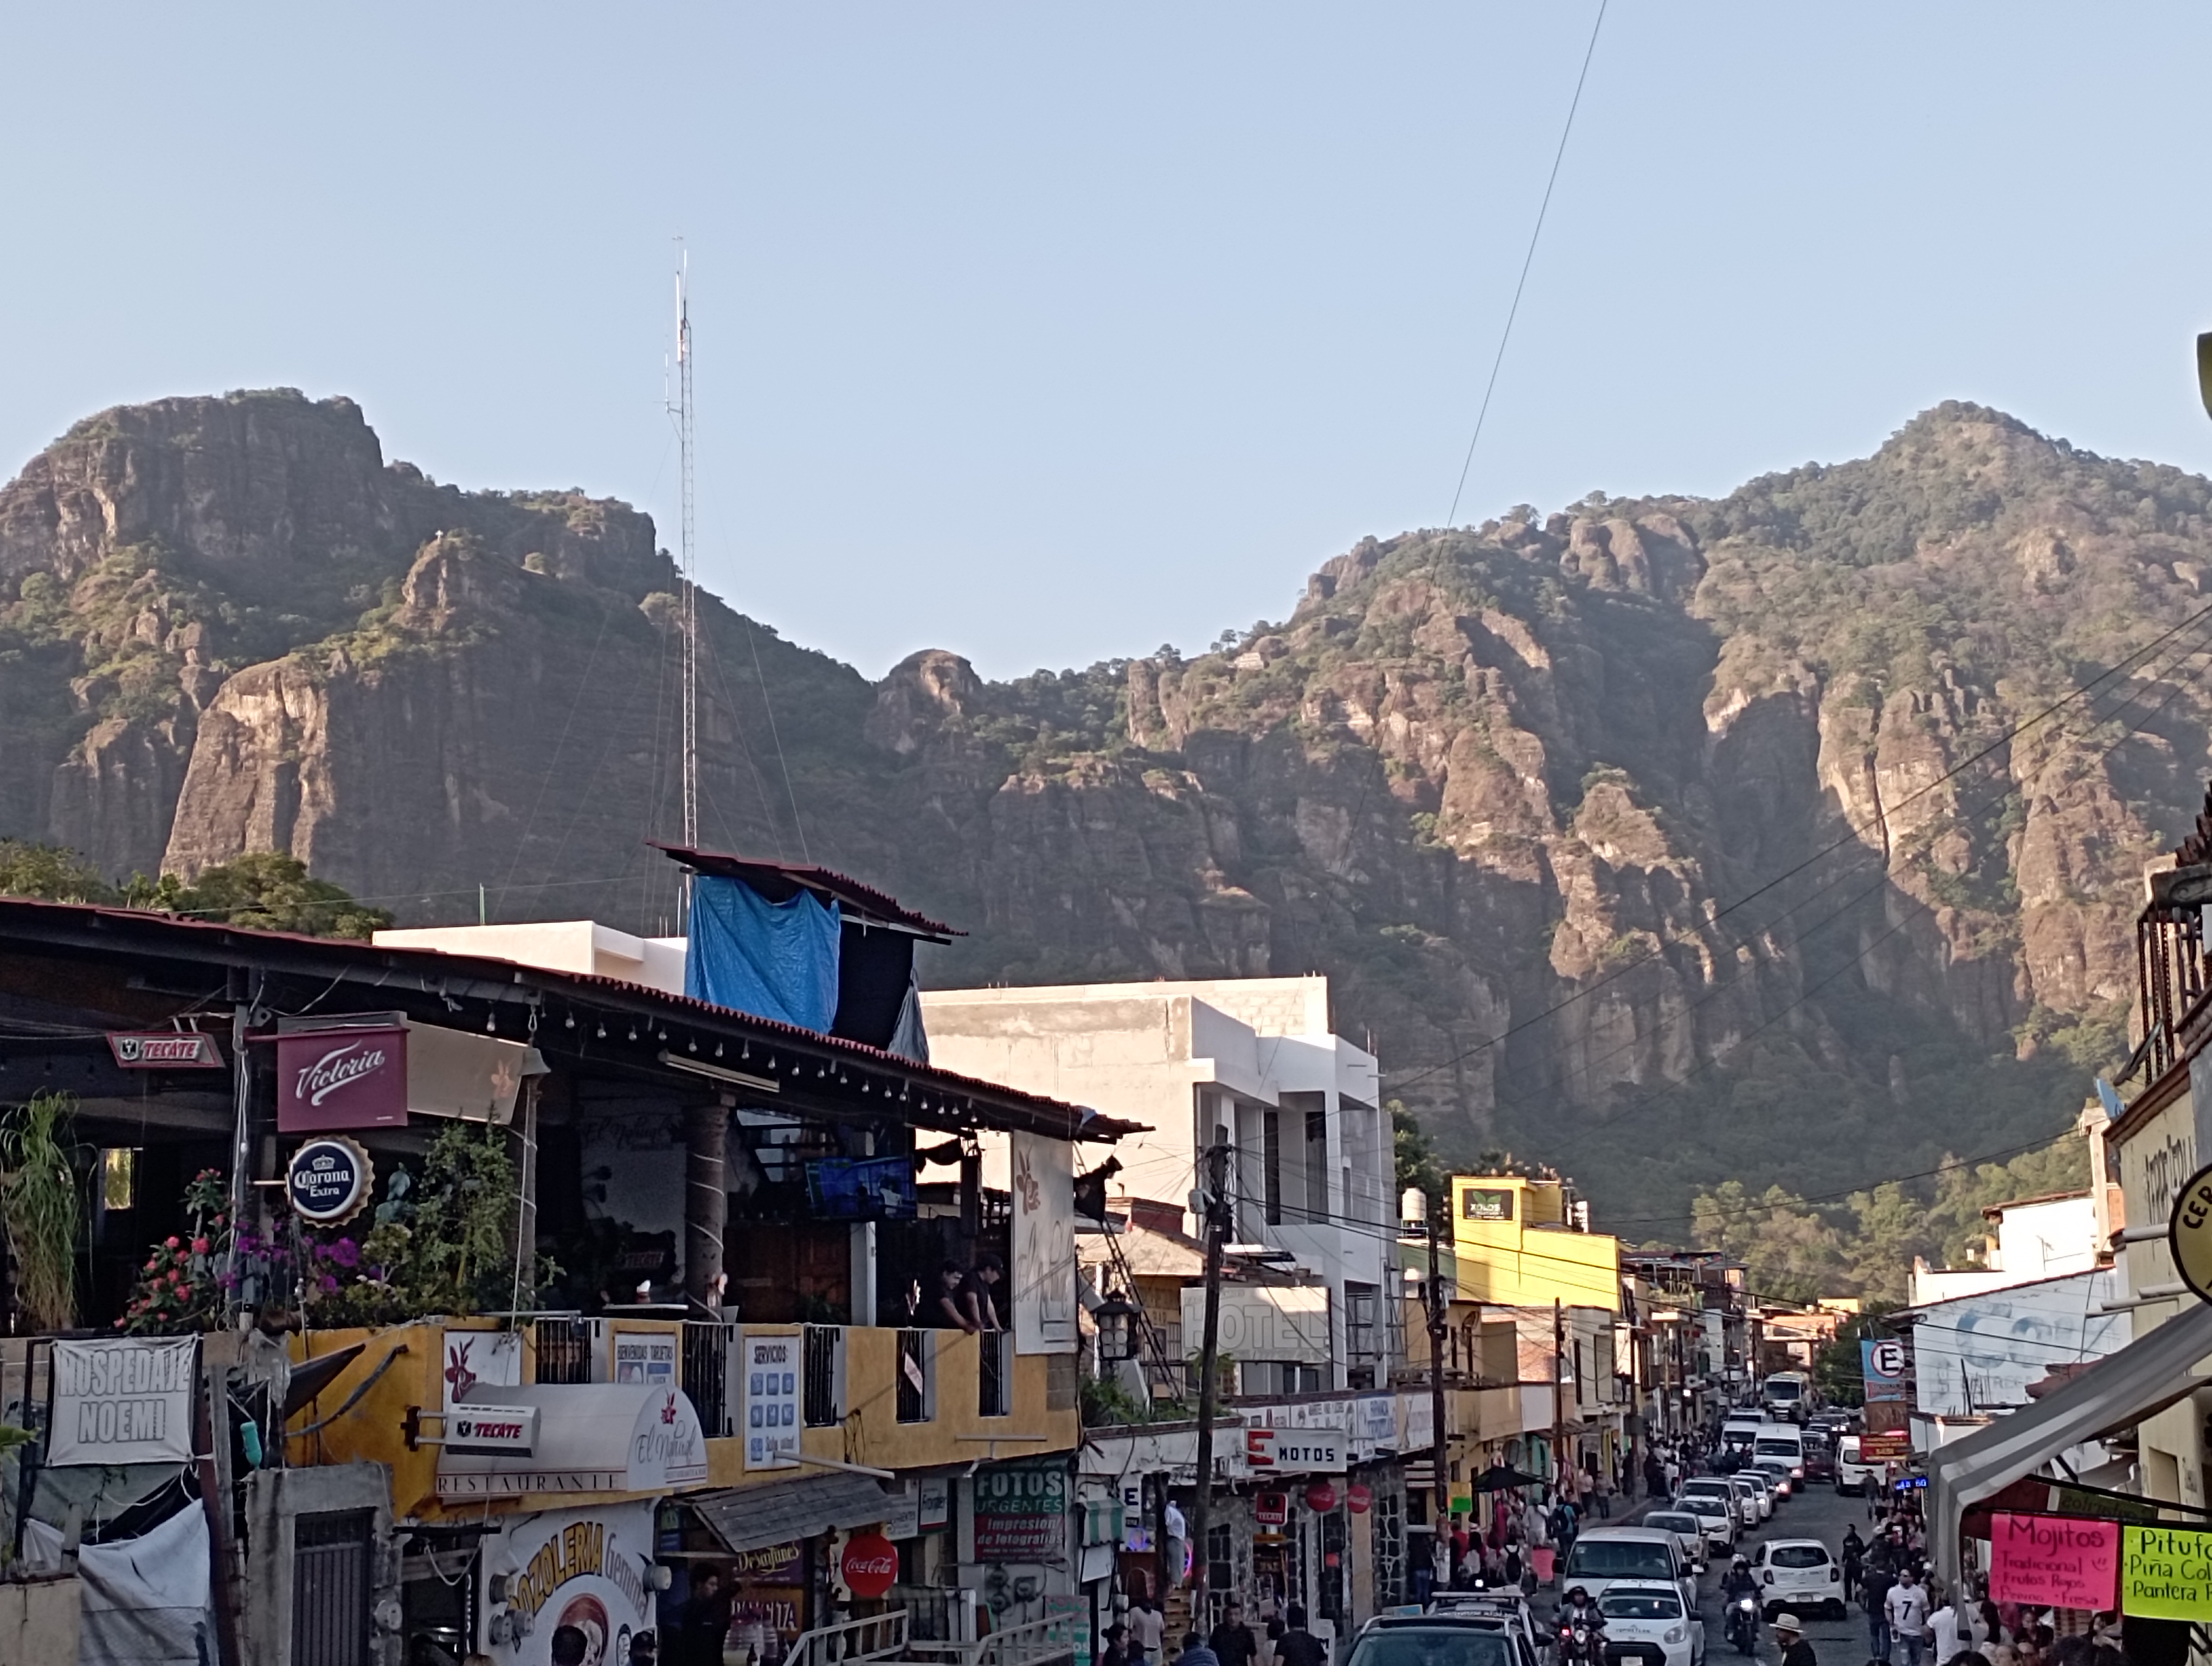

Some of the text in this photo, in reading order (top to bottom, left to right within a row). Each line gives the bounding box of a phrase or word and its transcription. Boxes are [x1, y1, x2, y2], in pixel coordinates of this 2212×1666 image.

[143, 1040, 200, 1059] TECATE
[295, 1039, 385, 1106] Victoria
[294, 1169, 351, 1190] Corona
[310, 1185, 340, 1197] Extra
[1184, 1304, 1330, 1349] HOTEL
[1880, 1348, 1899, 1372] E
[59, 1347, 191, 1397] HOSPEDAJE
[78, 1399, 166, 1444] NOEMI
[474, 1422, 523, 1439] TECATE
[1279, 1447, 1335, 1462] MOTOS
[438, 1473, 620, 1492] RESTAURANTE
[977, 1471, 1063, 1497] FOTOS
[976, 1499, 1063, 1513] URGENTES
[1124, 1488, 1139, 1505] E
[2008, 1517, 2105, 1556] Mojitos
[846, 1556, 892, 1574] Coca-Cola
[2002, 1550, 2082, 1575] Tradicional
[2130, 1554, 2173, 1579] Piña
[2133, 1580, 2197, 1601] Pantera
[1902, 1600, 1913, 1620] 7
